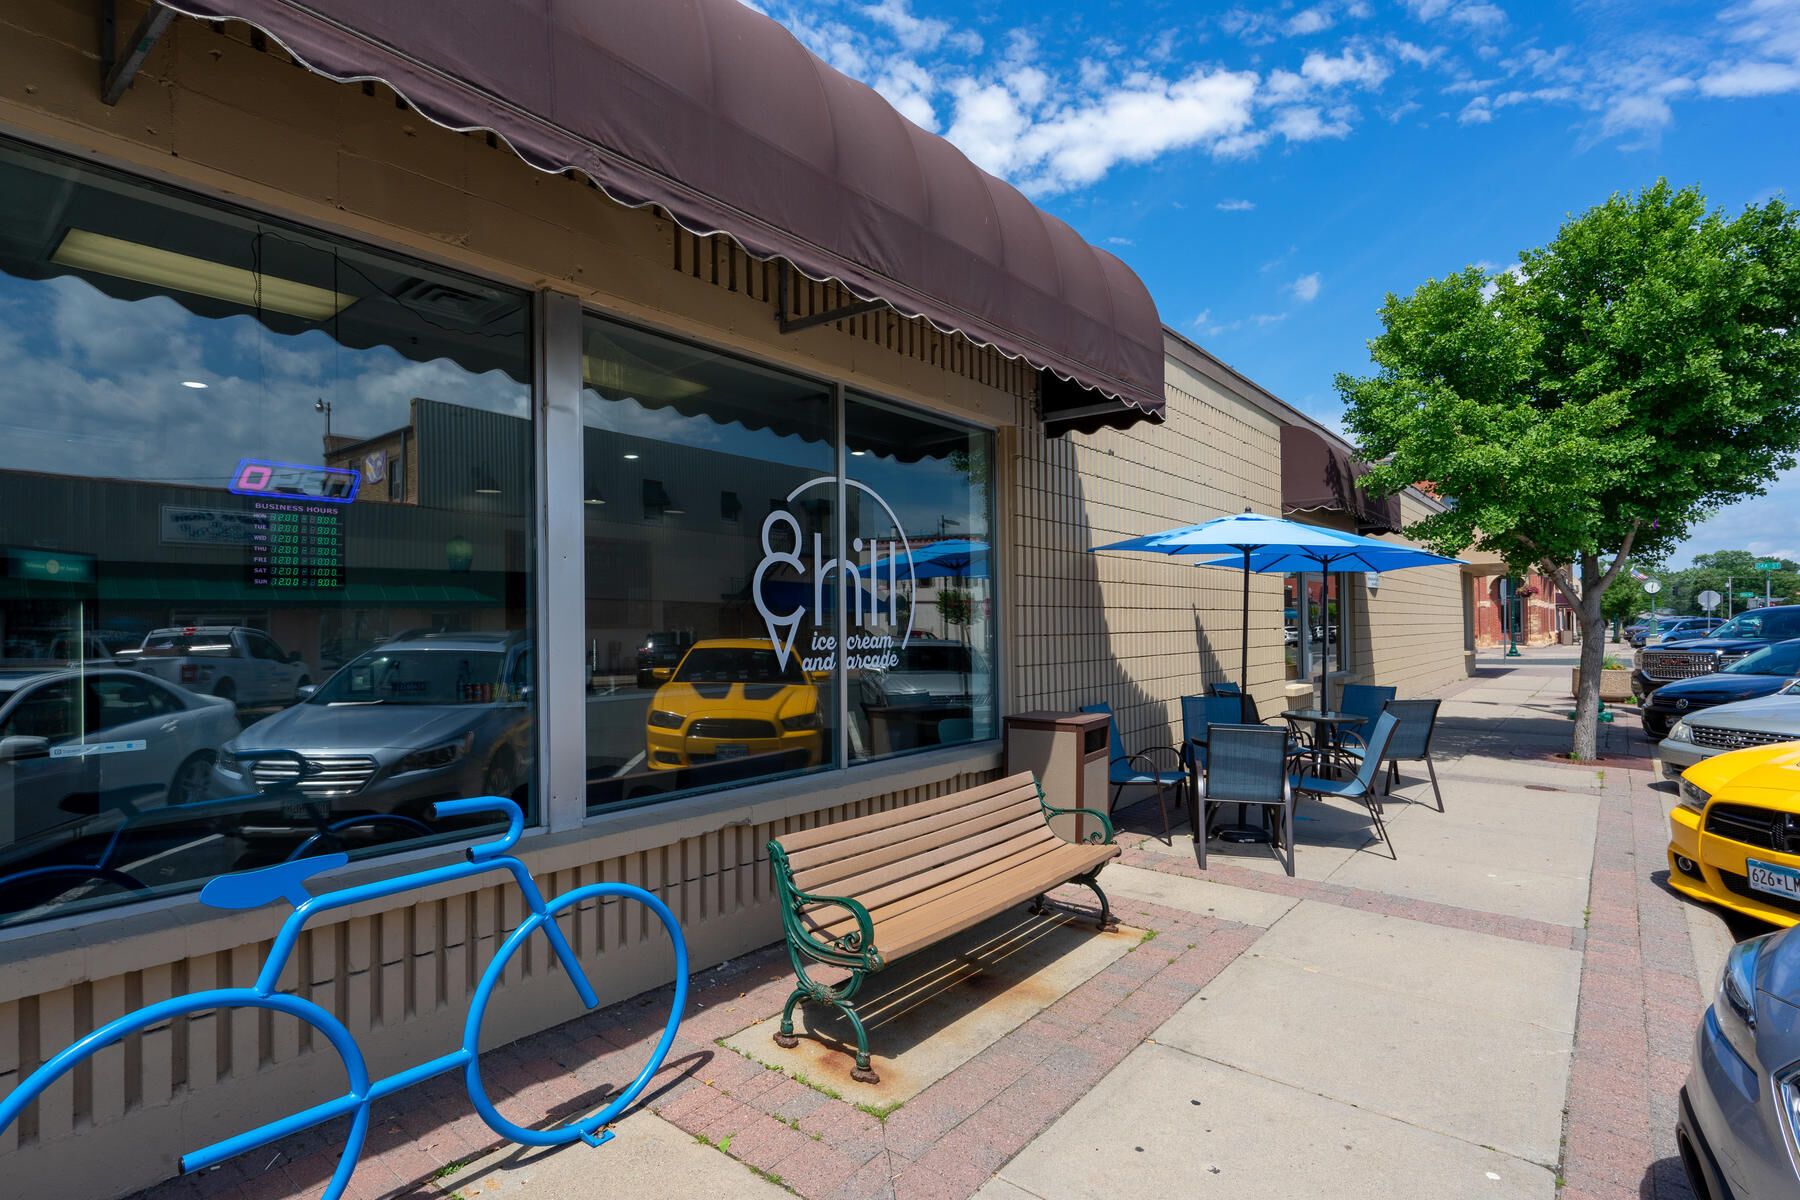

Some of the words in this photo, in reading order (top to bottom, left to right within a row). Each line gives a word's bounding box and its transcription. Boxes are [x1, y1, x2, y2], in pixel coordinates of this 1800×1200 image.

[255, 502, 304, 512] BUSINESS
[306, 506, 338, 515] HOURS
[753, 530, 897, 629] Chill
[811, 631, 837, 651] ice
[846, 635, 894, 651] cream
[801, 652, 836, 672] and
[846, 650, 899, 670] arcade
[1752, 868, 1775, 887] 626
